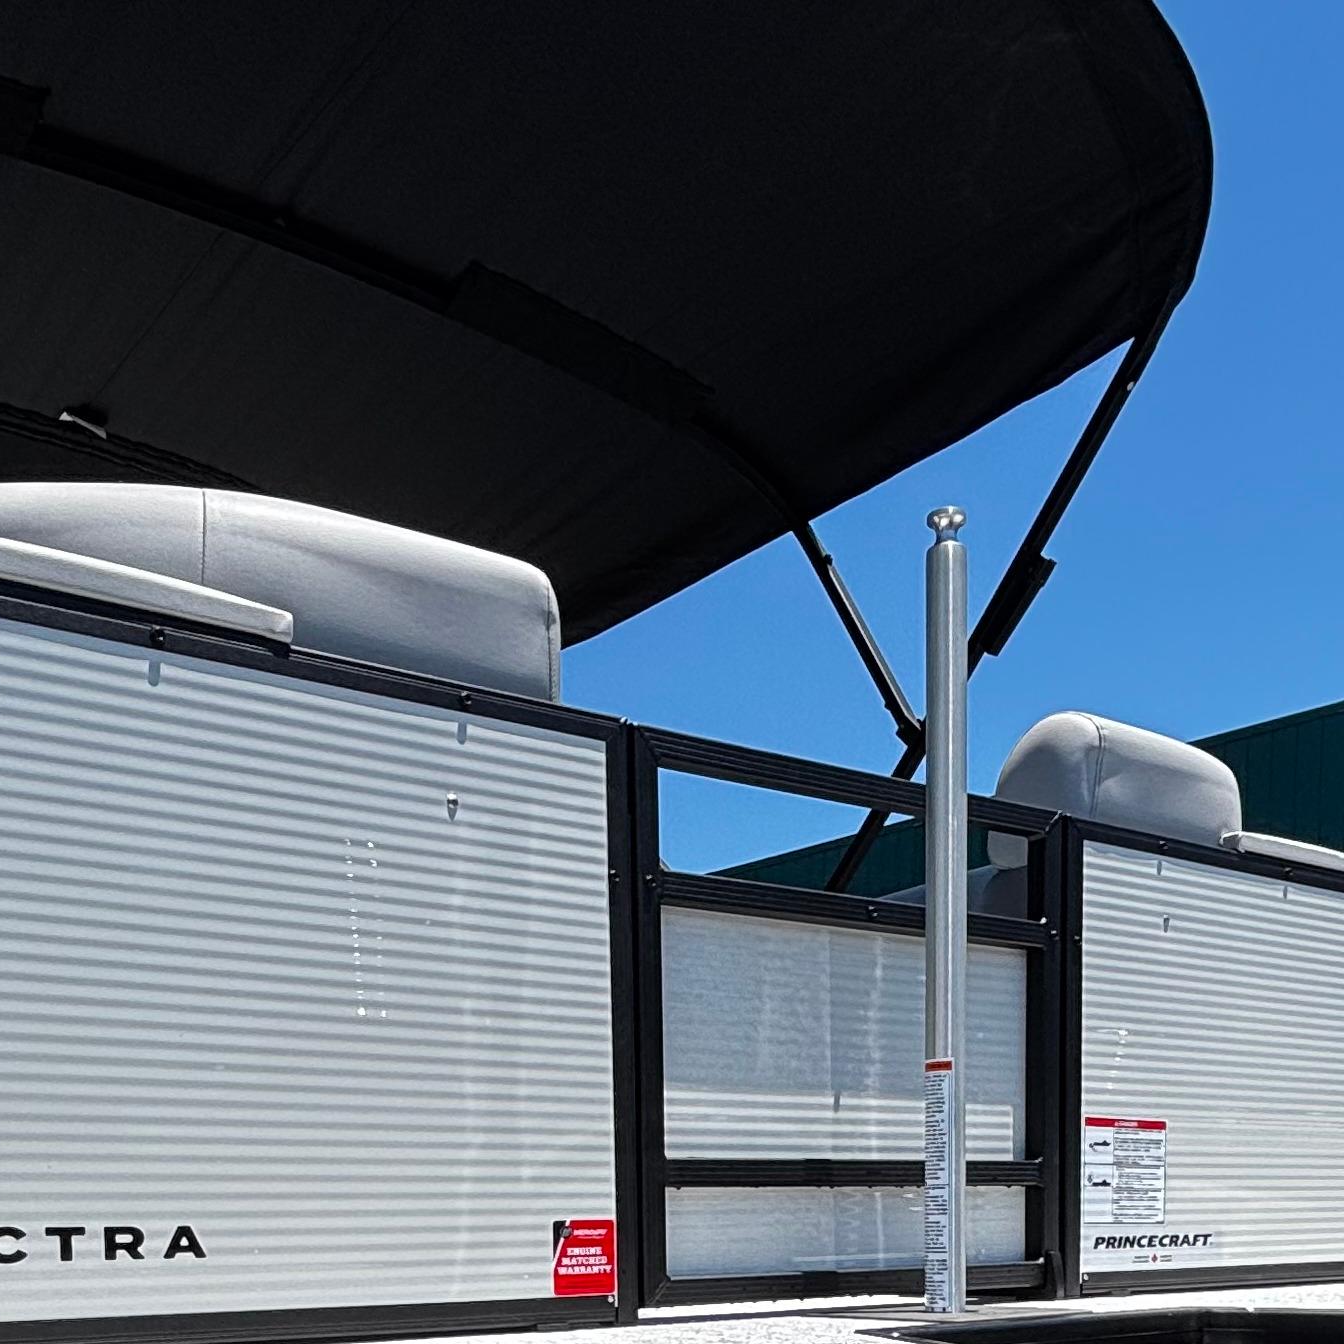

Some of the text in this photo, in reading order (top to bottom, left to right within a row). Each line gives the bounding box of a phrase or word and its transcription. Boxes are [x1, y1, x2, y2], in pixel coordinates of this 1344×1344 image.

[1093, 1233, 1212, 1249] PRINCECRAFT
[566, 1246, 603, 1256] ENGINE
[560, 1256, 608, 1266] MATCHED
[557, 1264, 613, 1275] WARRANTY
